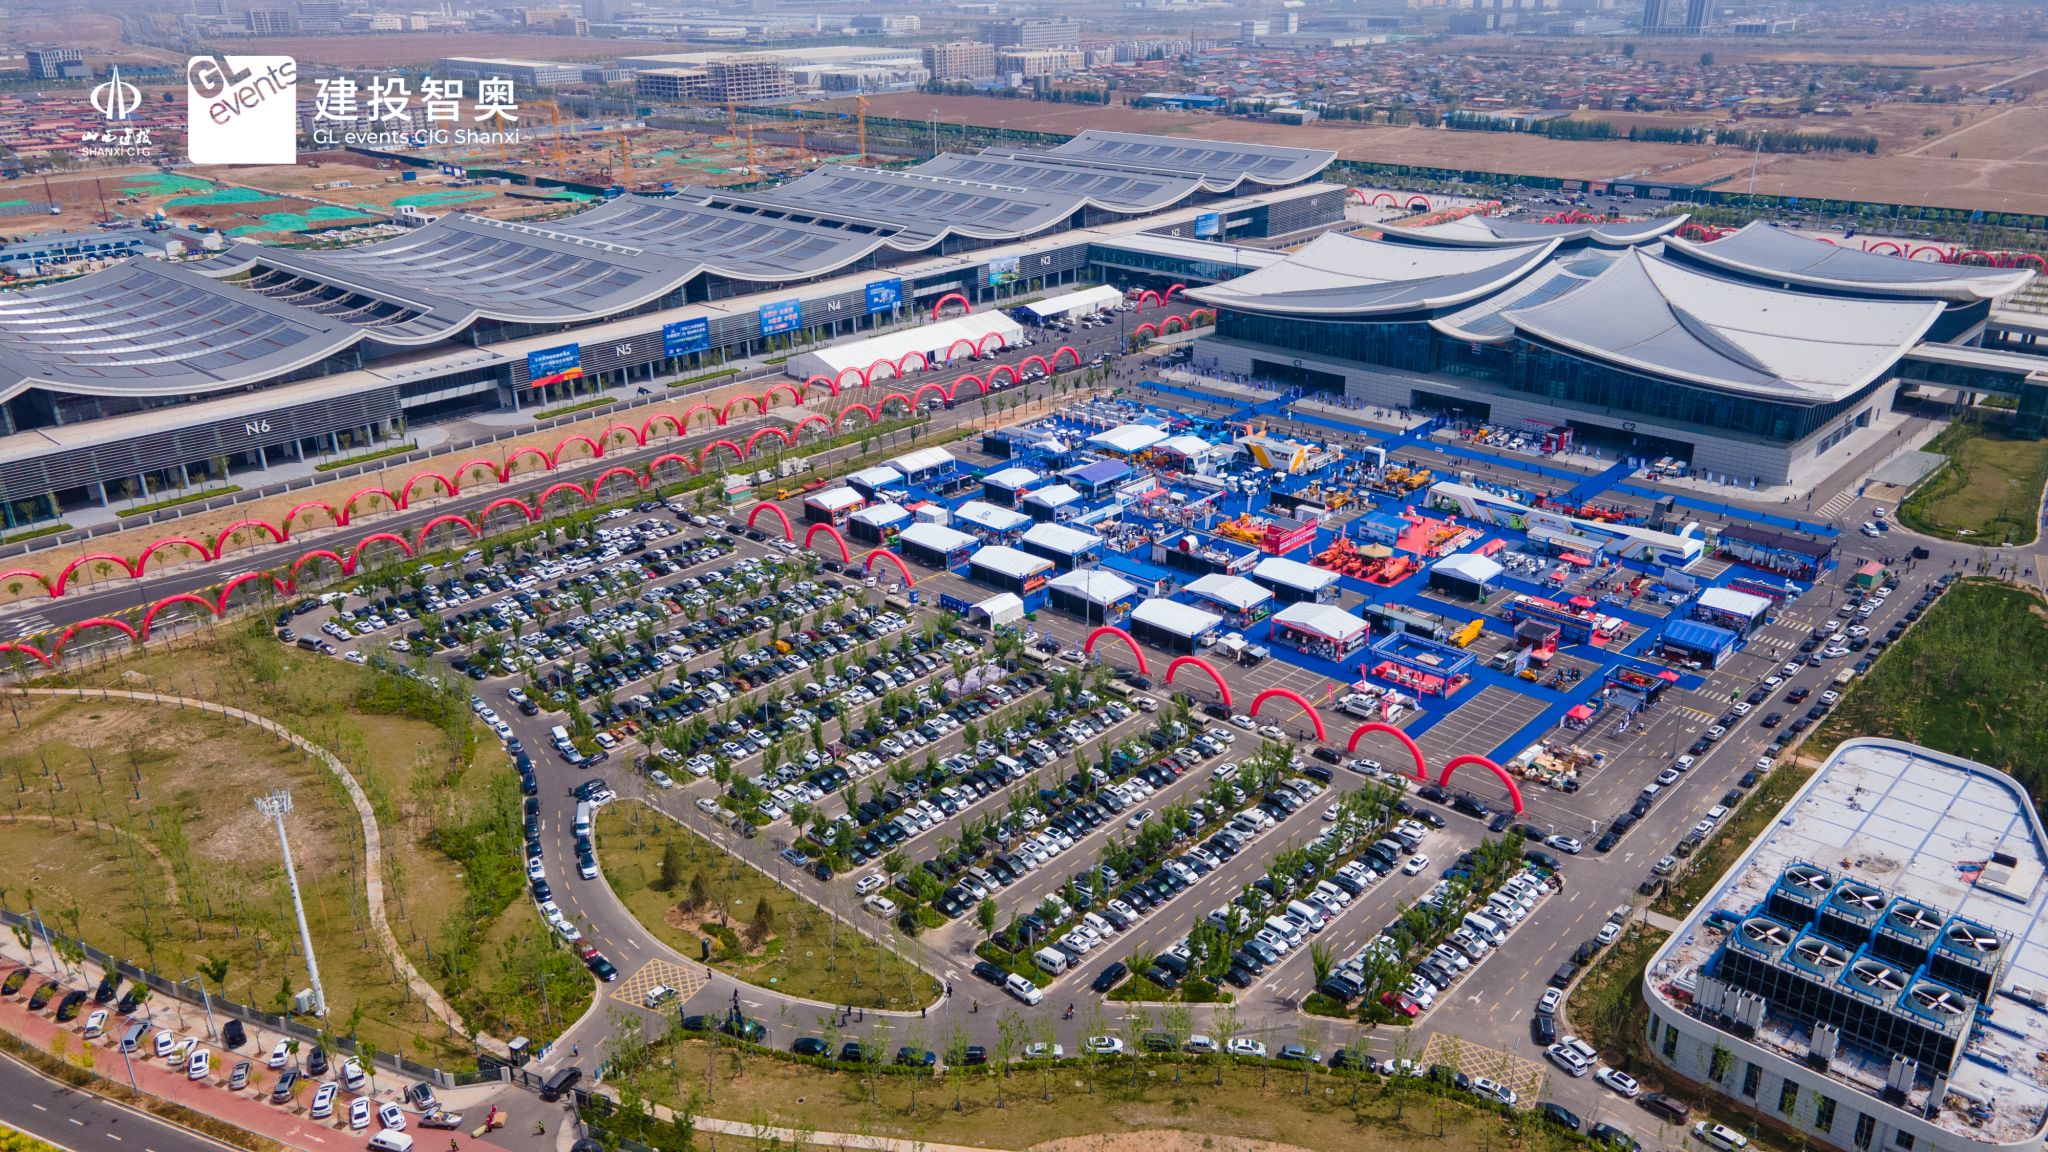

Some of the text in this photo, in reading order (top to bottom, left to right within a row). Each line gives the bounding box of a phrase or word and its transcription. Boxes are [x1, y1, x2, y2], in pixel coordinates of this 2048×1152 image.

[827, 300, 841, 312] N4
[616, 343, 632, 357] N5
[245, 419, 270, 436] N6
[1622, 421, 1636, 432] C2
